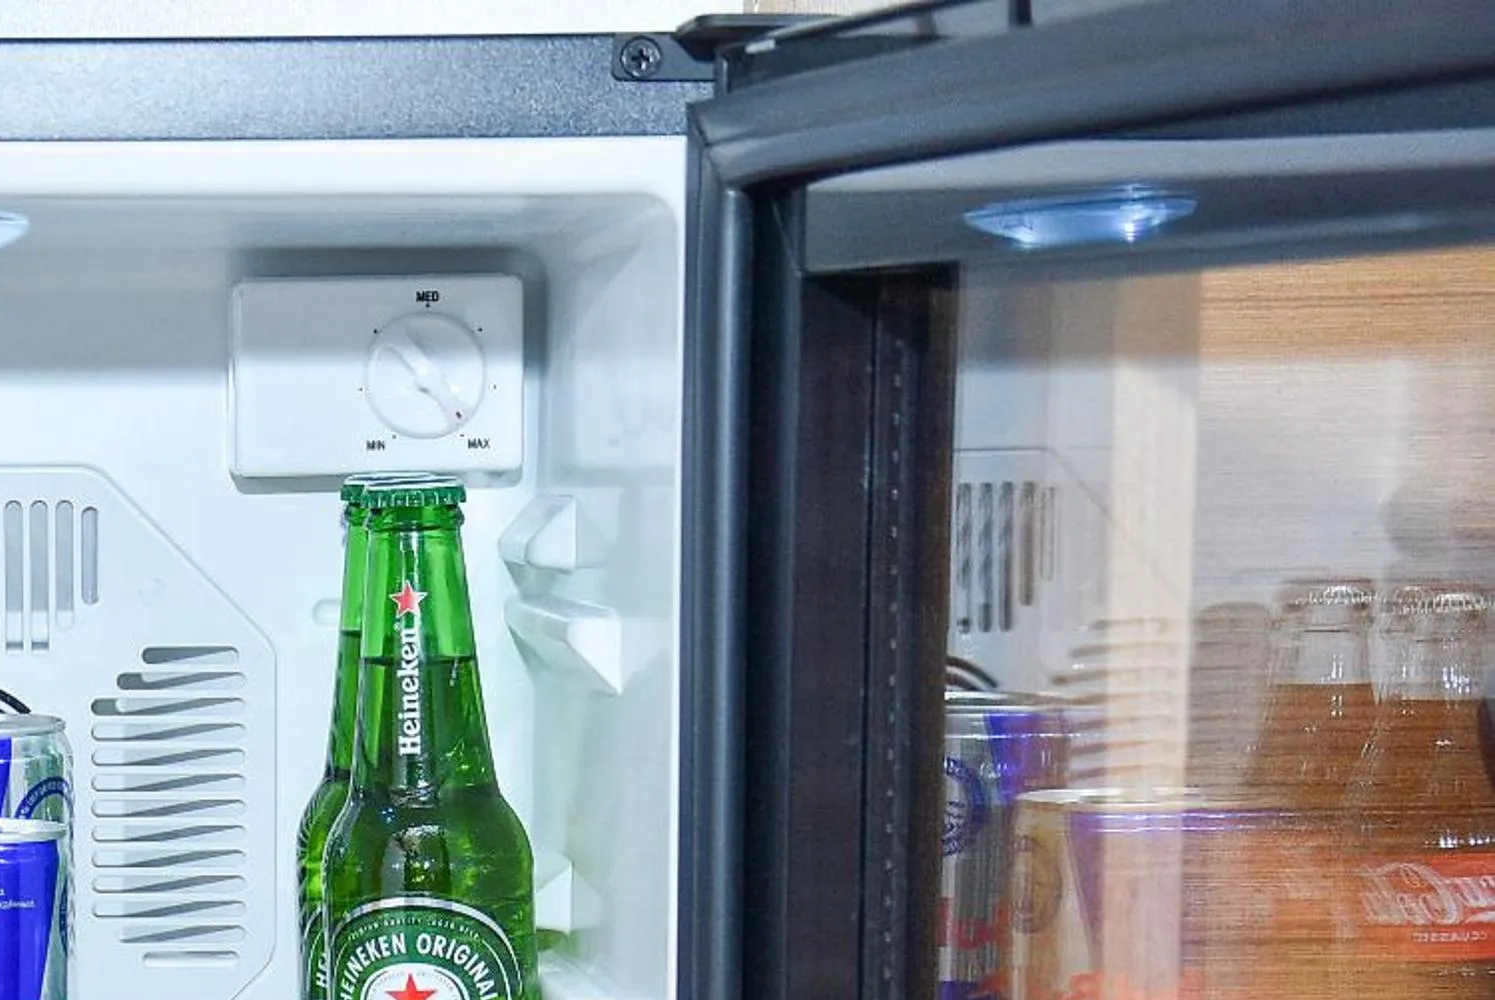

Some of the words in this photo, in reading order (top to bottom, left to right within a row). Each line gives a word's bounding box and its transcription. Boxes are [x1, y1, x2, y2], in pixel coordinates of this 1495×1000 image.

[416, 291, 439, 303] MED
[366, 440, 386, 452] MIN
[467, 437, 490, 450] MAX
[396, 628, 421, 756] Heineken
